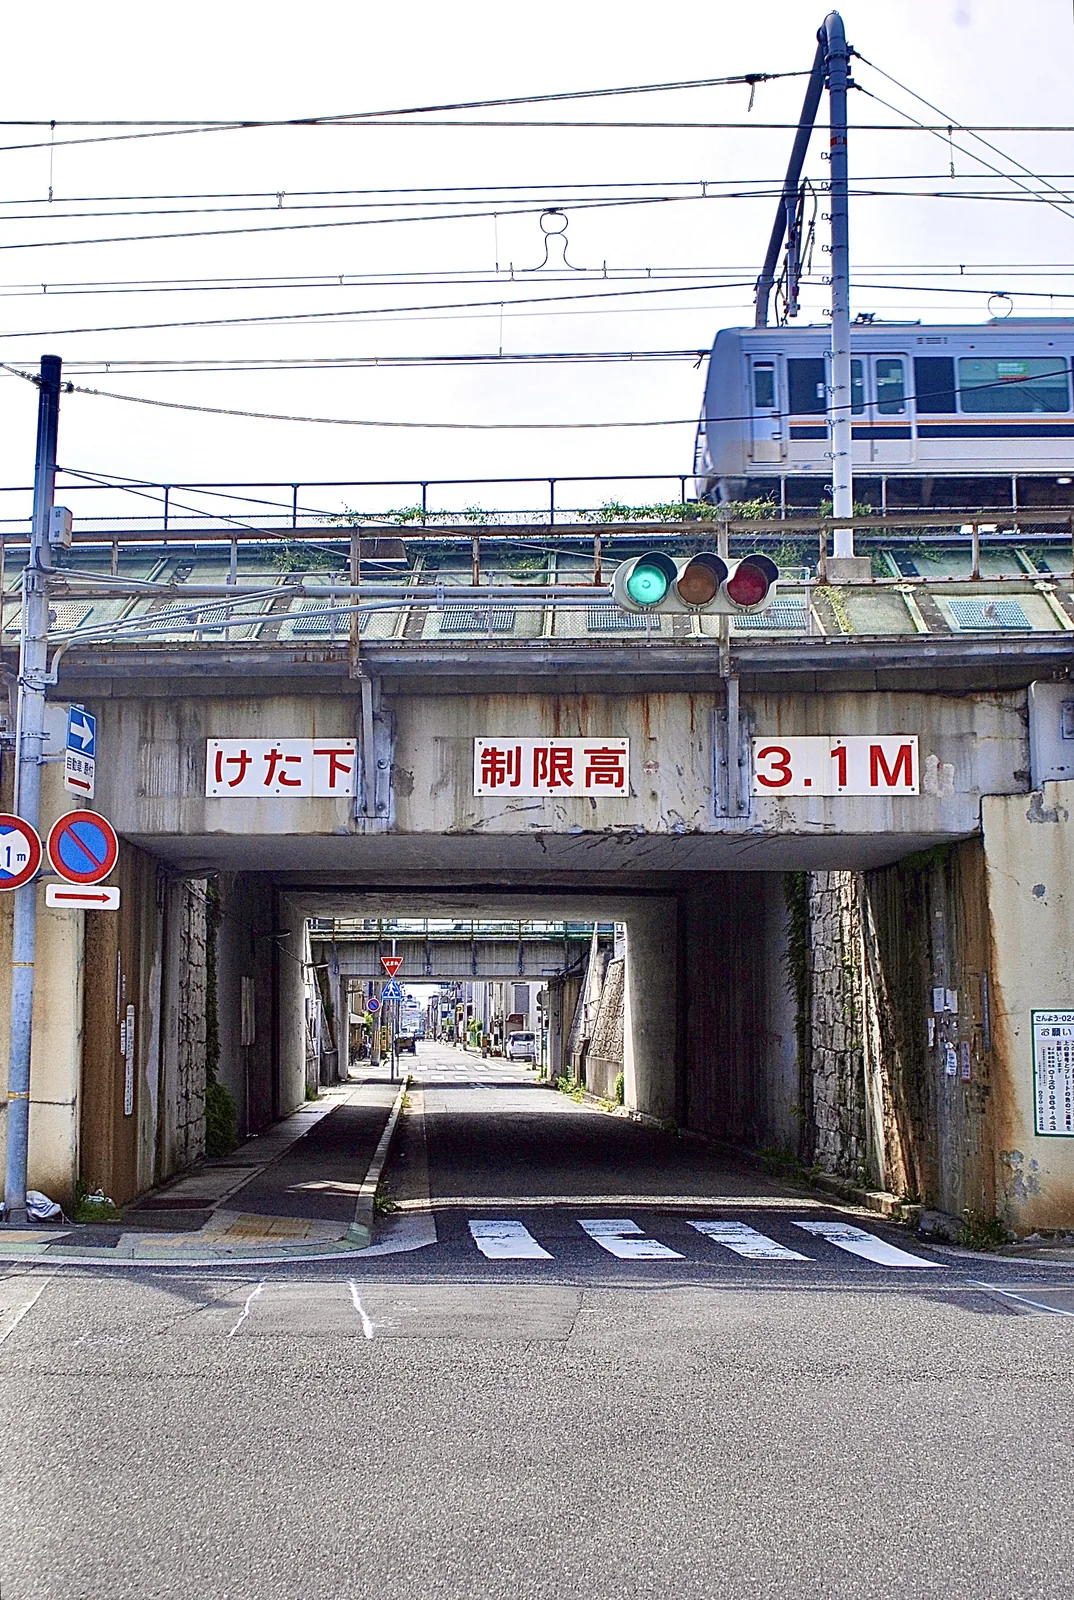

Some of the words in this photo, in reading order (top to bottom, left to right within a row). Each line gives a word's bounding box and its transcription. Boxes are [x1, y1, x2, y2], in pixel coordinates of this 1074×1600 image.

[215, 749, 355, 788] けた下
[481, 746, 626, 789] 制限高
[757, 744, 913, 788] 3.1M
[1040, 1027, 1072, 1037] お願い
